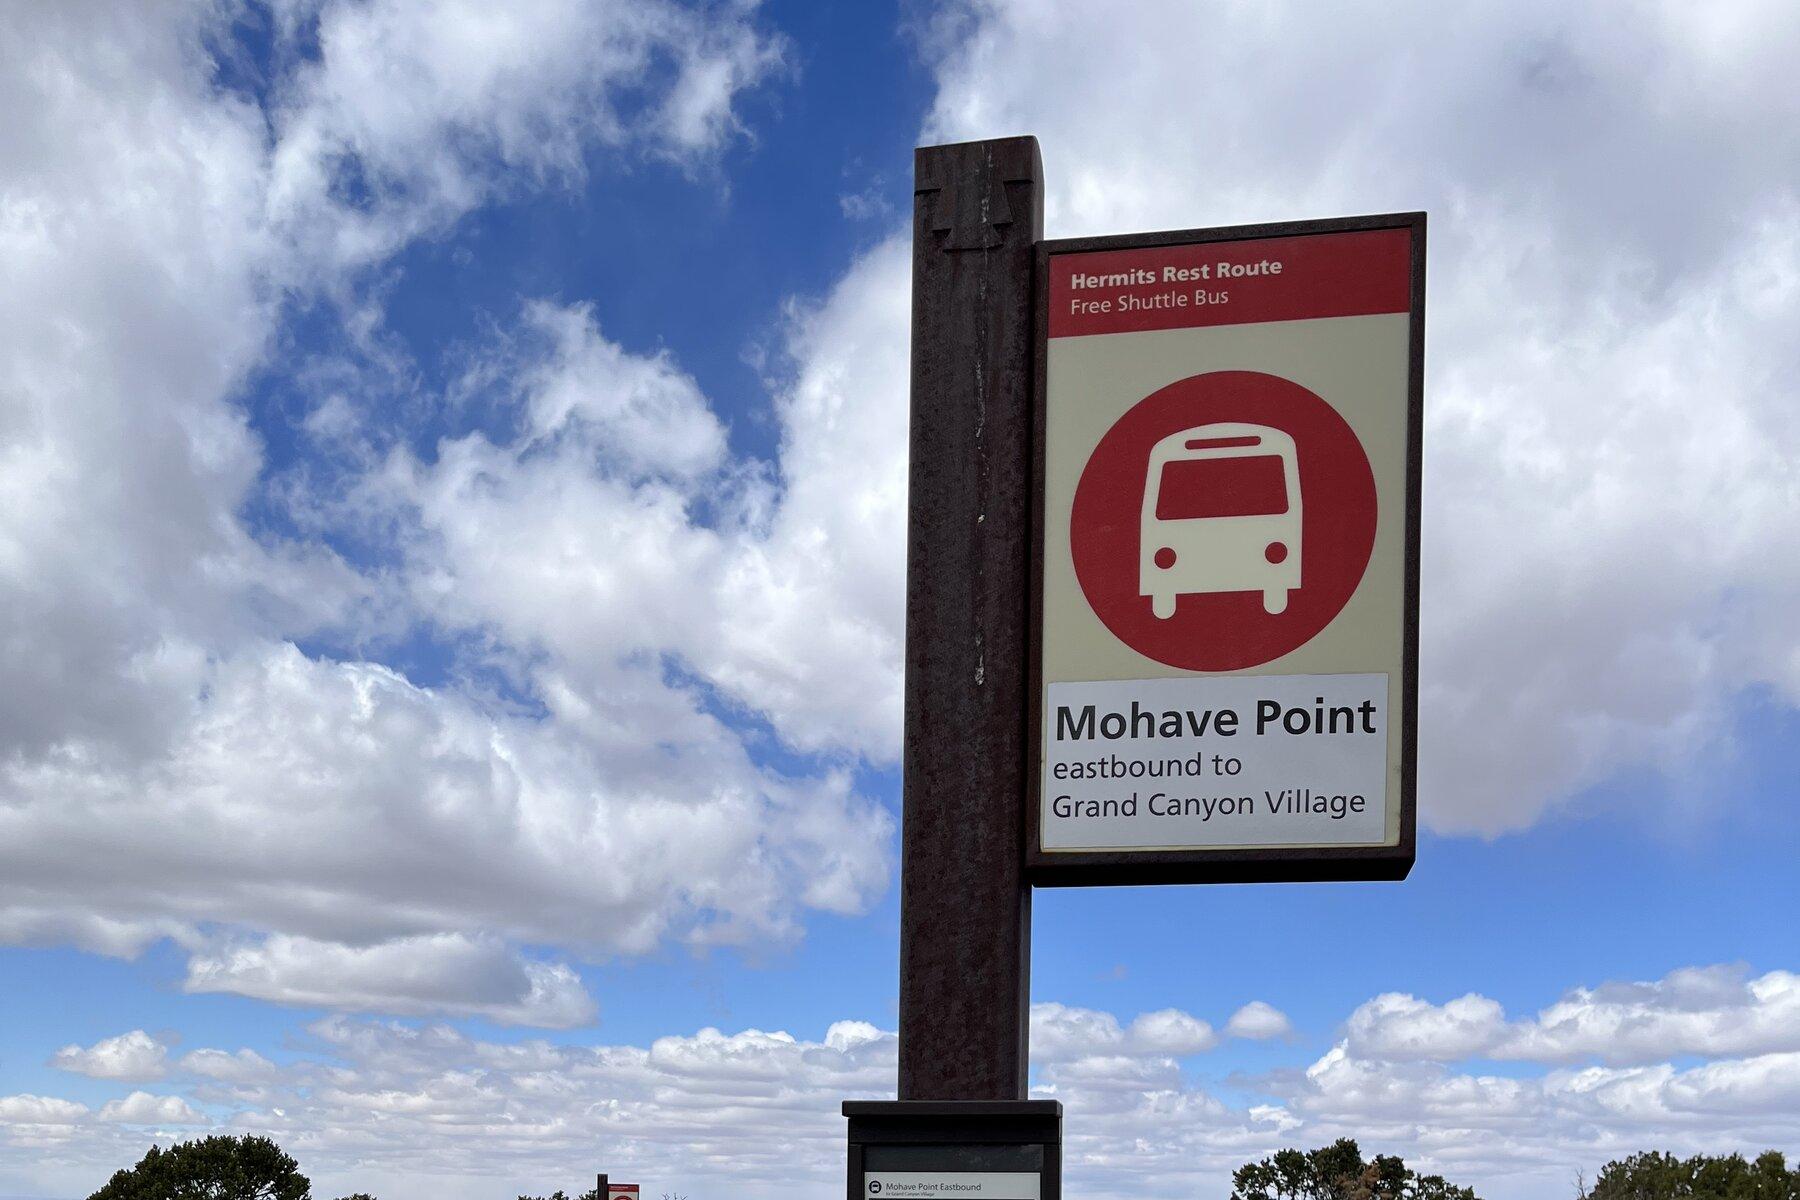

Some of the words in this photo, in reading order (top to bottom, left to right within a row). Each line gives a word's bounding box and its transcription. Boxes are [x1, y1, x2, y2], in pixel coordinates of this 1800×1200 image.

[1071, 267, 1156, 290] Hermits
[1163, 263, 1211, 283] Rest
[1217, 258, 1283, 278] Route
[1071, 297, 1112, 315] Free
[1118, 290, 1188, 312] Shuttle
[1195, 289, 1229, 306] Bus
[1056, 701, 1239, 741] Mohave
[1256, 697, 1377, 736] Point
[1053, 752, 1202, 780] eastbound
[1211, 754, 1242, 776] to
[1052, 792, 1138, 818] Grand
[1150, 793, 1254, 822] Canyon
[1264, 788, 1366, 819] Village
[940, 1183, 982, 1191] Eastbound
